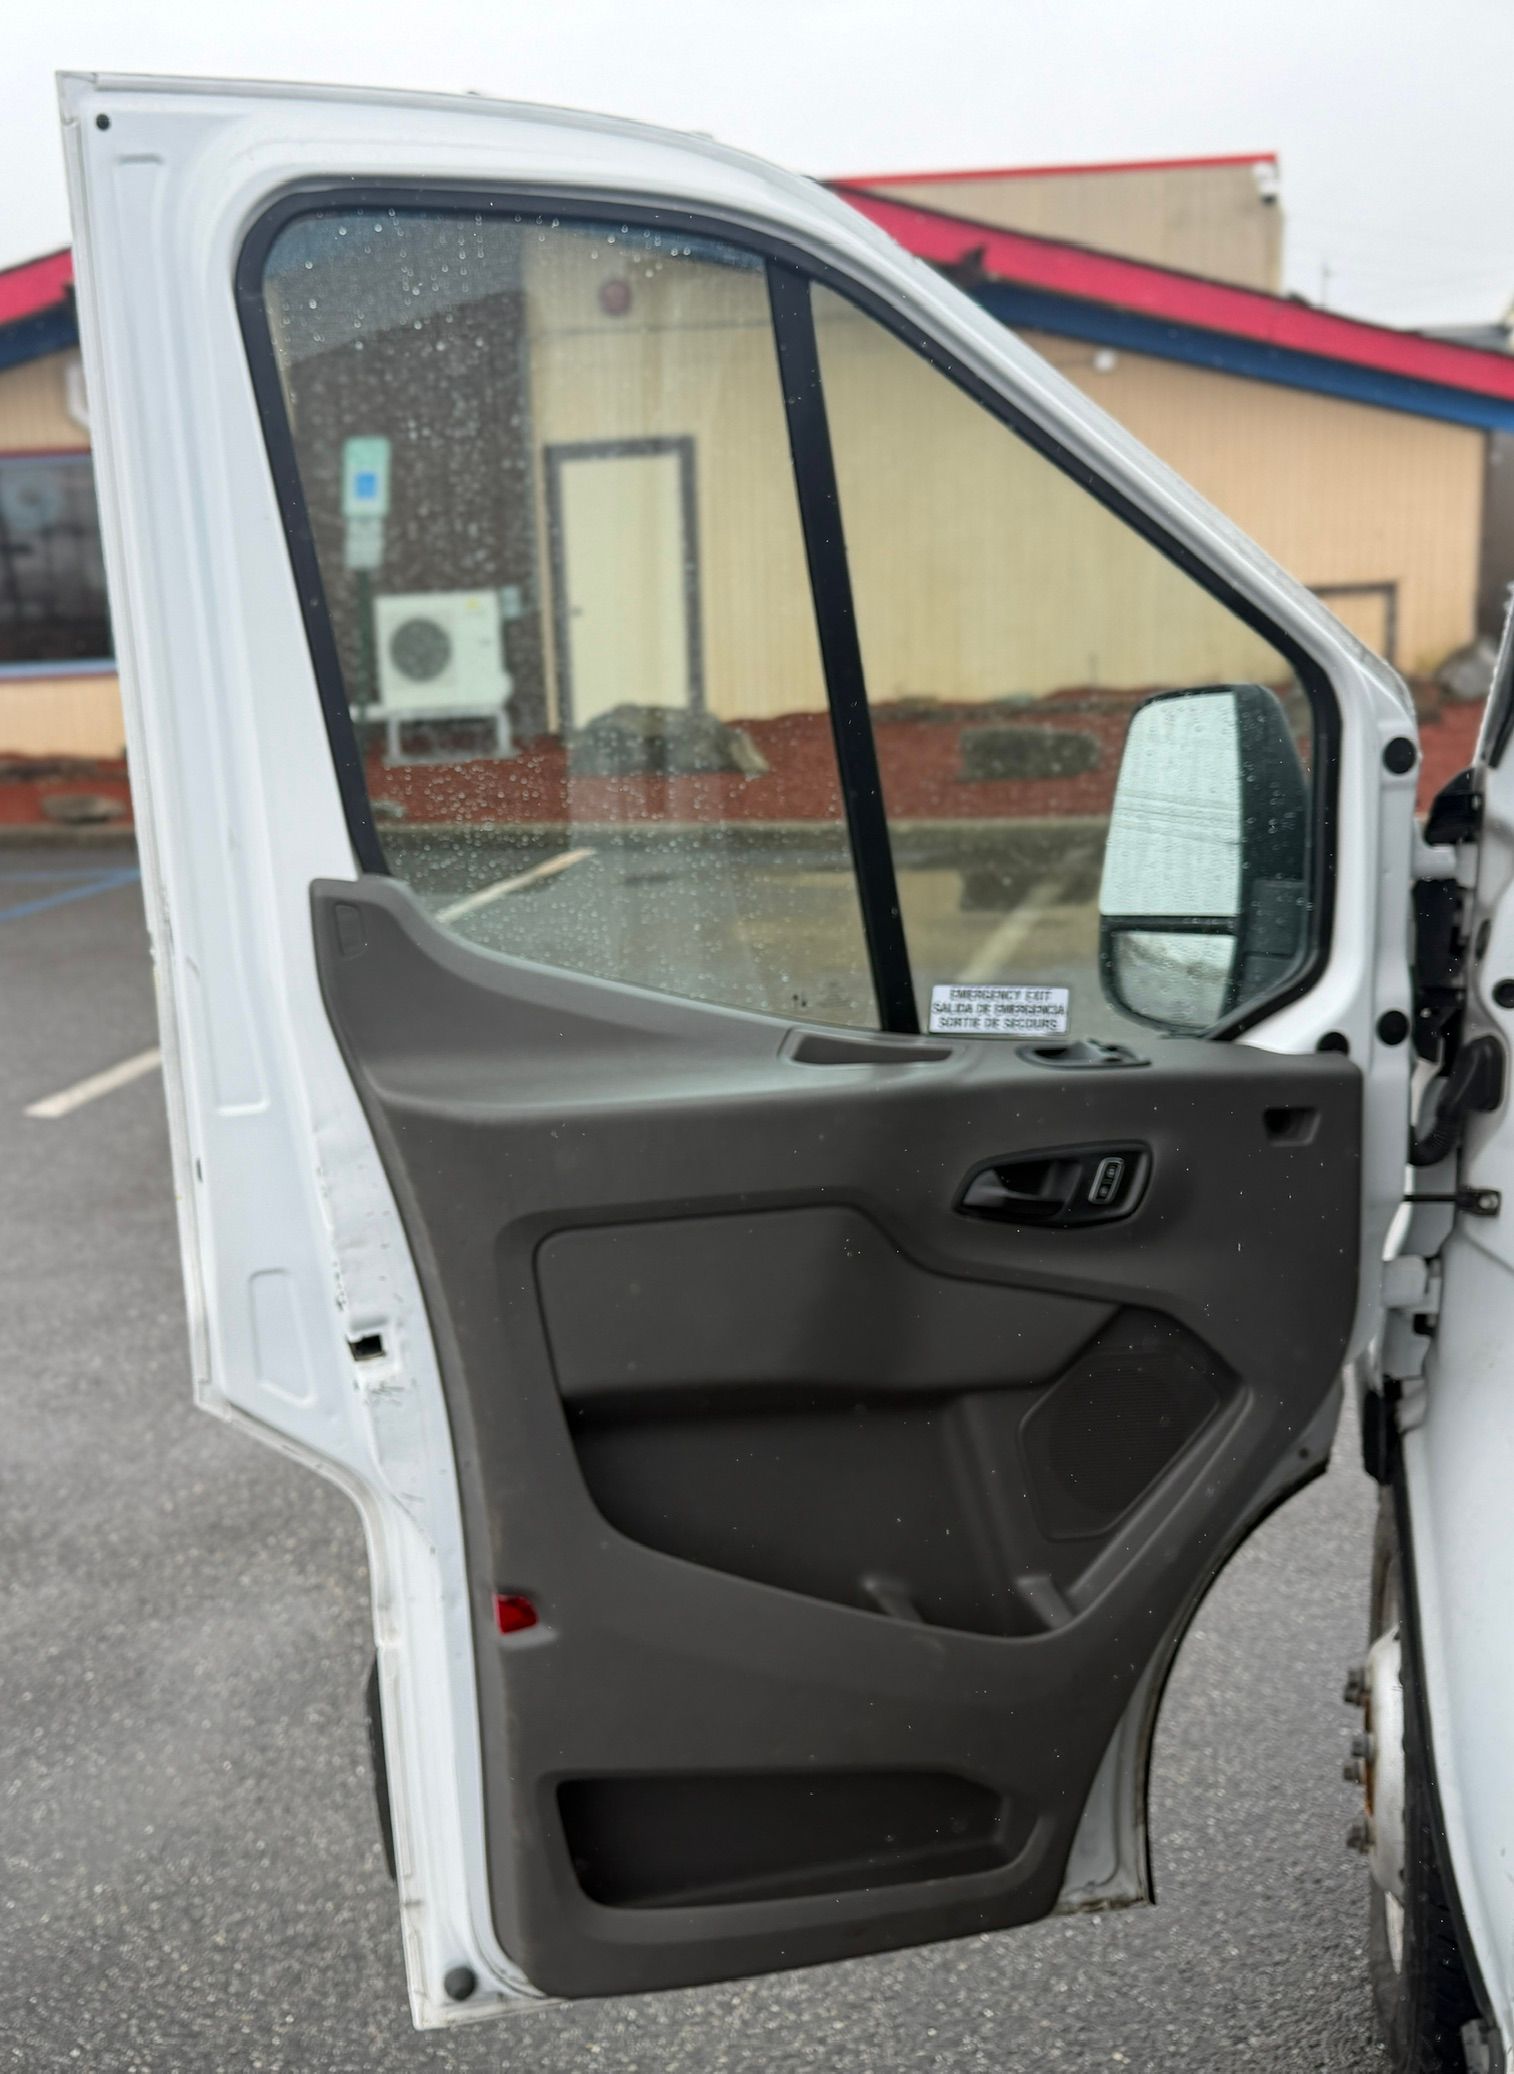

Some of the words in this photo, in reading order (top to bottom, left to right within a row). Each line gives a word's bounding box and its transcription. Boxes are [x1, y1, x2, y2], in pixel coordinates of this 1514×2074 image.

[950, 989, 1021, 1000] EMERGENCY
[1025, 991, 1052, 1001] EXIT
[932, 1003, 973, 1013] SALIDA
[976, 1004, 991, 1013] DE
[994, 1004, 1065, 1015] EMERGENCIA
[939, 1017, 980, 1028] SORTIE
[984, 1018, 1000, 1028] DE
[1004, 1018, 1057, 1030] SECOURS
